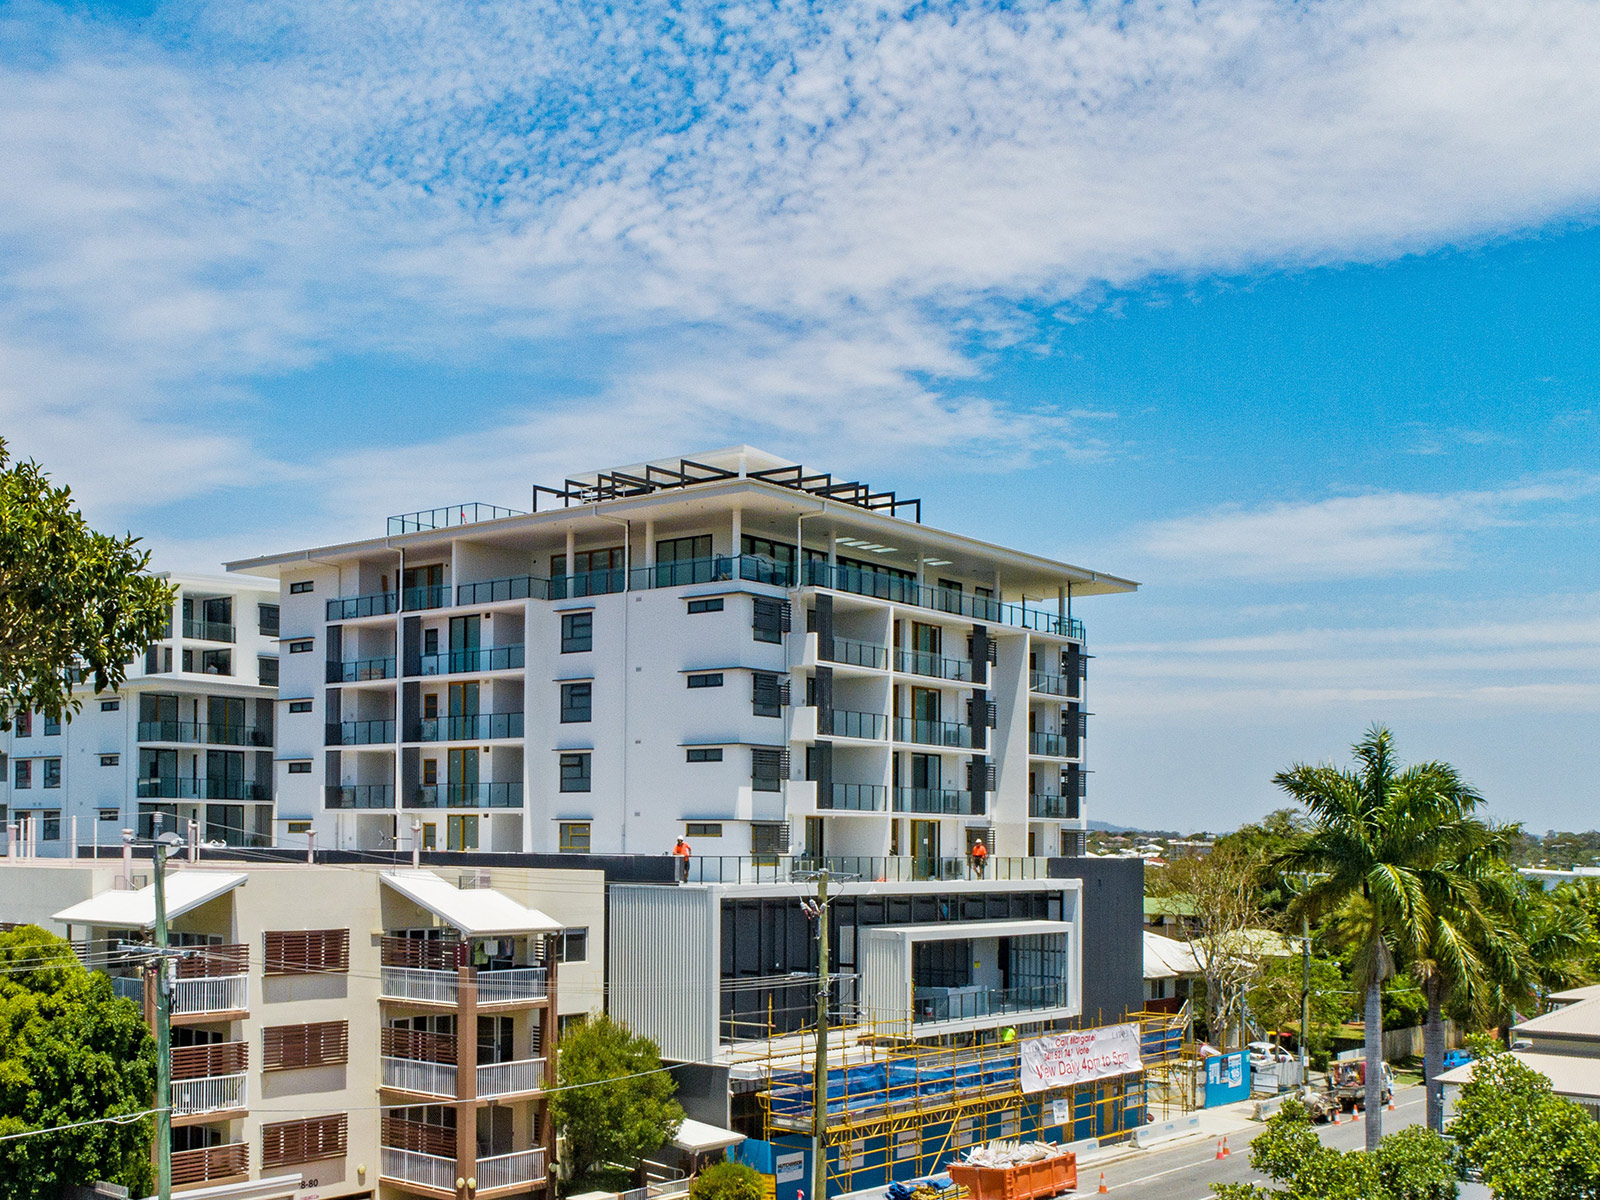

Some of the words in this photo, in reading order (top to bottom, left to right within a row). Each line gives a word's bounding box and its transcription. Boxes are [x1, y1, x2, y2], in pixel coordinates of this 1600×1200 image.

[1055, 1036, 1068, 1047] Call
[1070, 1033, 1096, 1045] Margare
[1035, 1063, 1056, 1079] Vew
[1058, 1060, 1080, 1076] Daiy
[1081, 1057, 1100, 1073] 4pm
[1102, 1055, 1111, 1067] to
[1112, 1051, 1128, 1068] 5pm
[299, 1178, 319, 1190] 8-80
